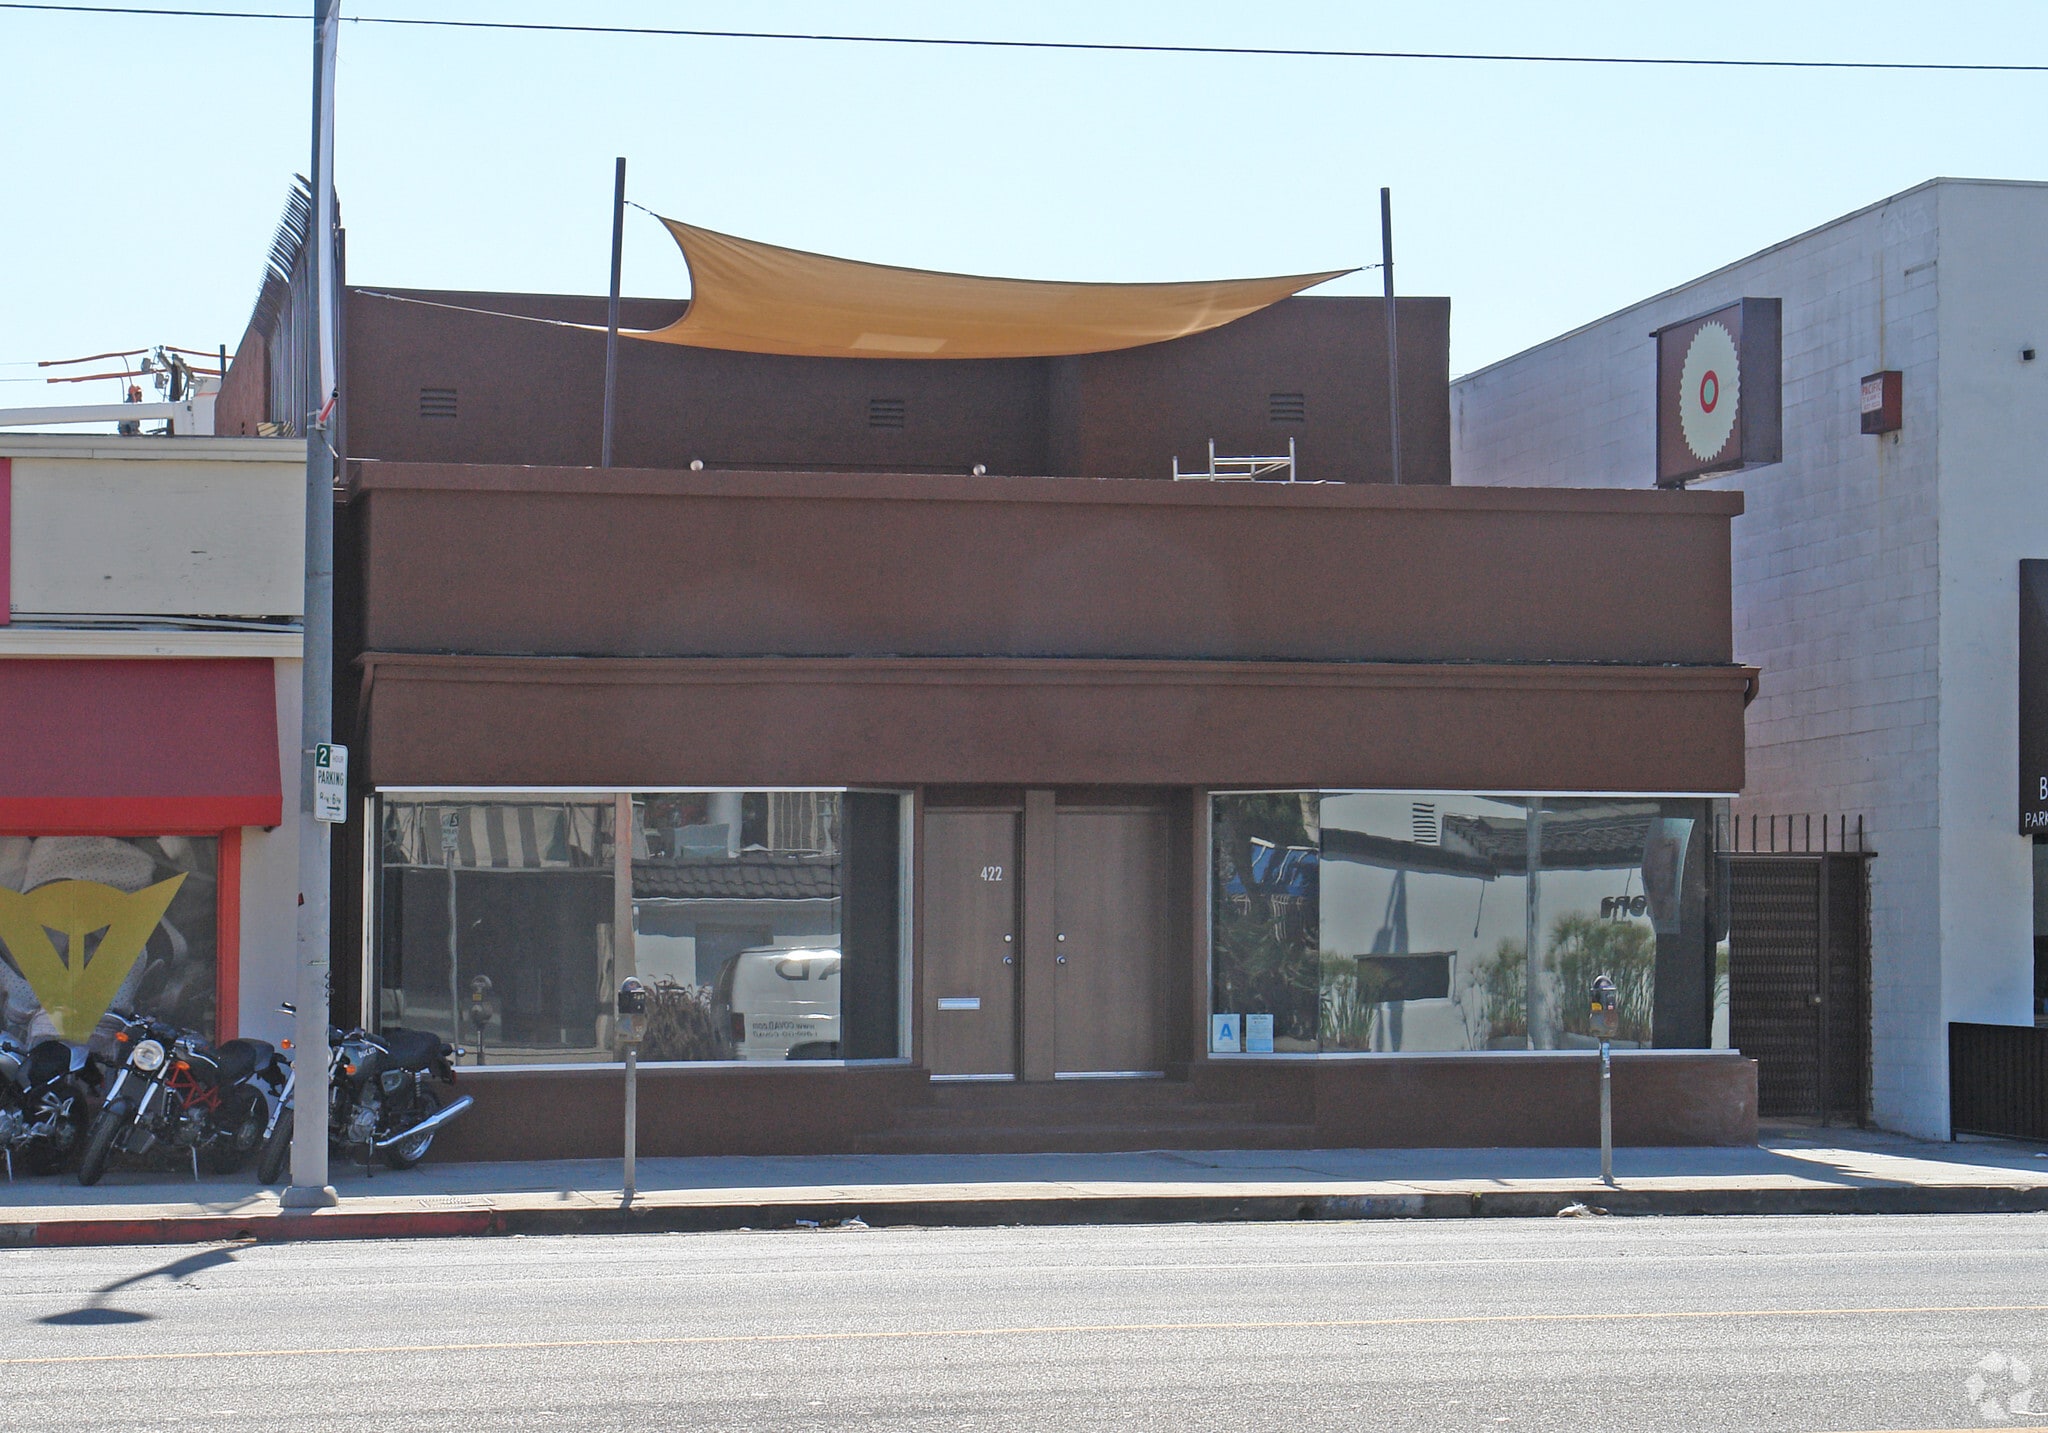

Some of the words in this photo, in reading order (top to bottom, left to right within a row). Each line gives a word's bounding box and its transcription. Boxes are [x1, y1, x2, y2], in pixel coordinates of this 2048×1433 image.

[320, 747, 327, 764] 2
[318, 770, 344, 786] PARKING
[980, 866, 1003, 881] 422
[1219, 1024, 1233, 1040] A
